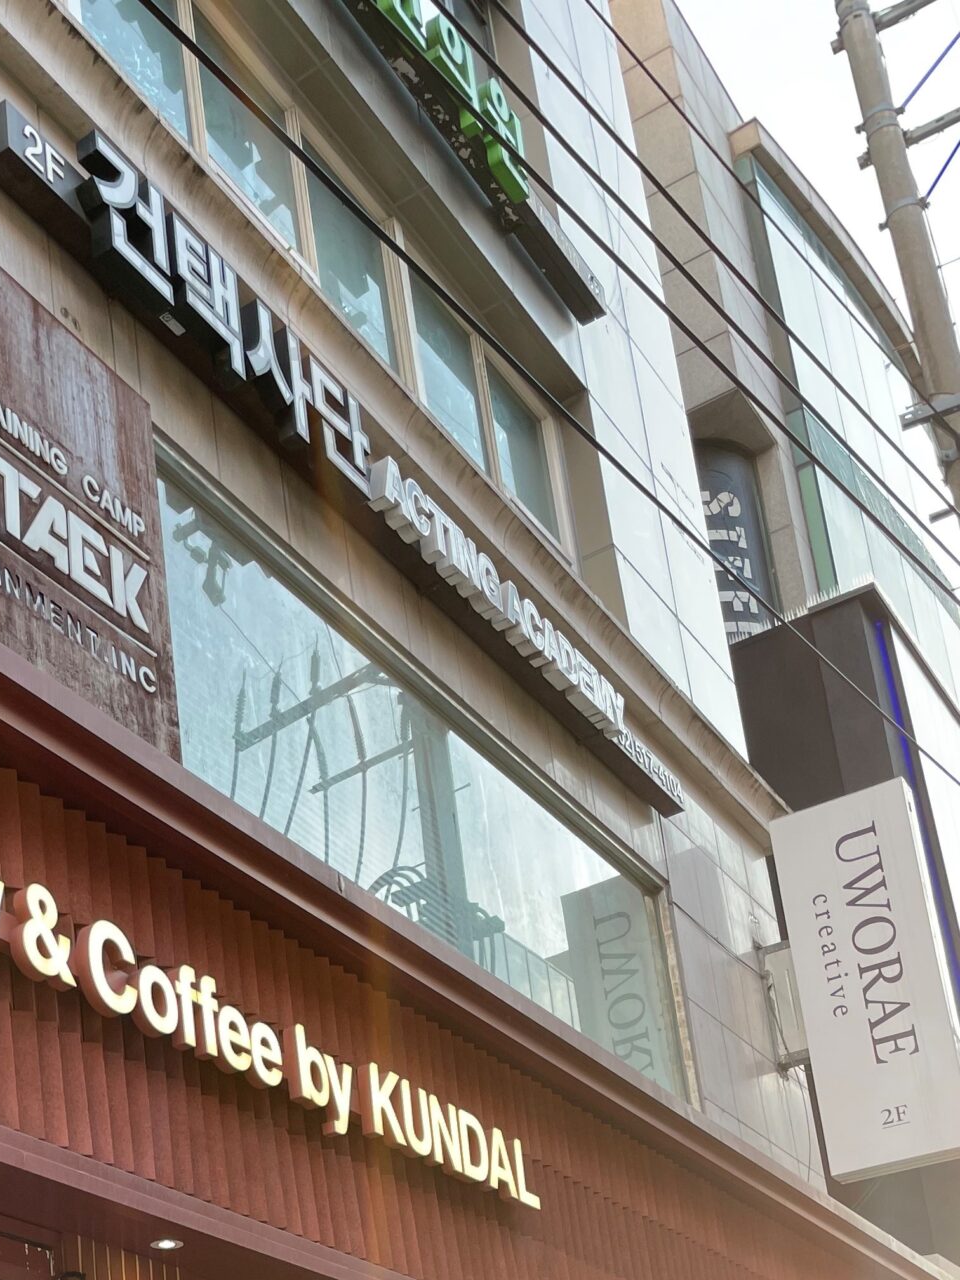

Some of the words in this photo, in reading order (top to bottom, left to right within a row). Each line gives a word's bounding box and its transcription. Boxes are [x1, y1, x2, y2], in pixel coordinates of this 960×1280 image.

[22, 124, 65, 184] 2F
[94, 133, 372, 499] 건택사단
[82, 474, 146, 536] CAMP
[384, 455, 505, 613] ACTING
[506, 579, 625, 733] ACADEMY
[812, 892, 849, 1018] creative
[834, 819, 921, 1065] UWORAE
[22, 882, 78, 988] &
[87, 919, 284, 1087] Coffee
[294, 1023, 353, 1135] by
[369, 1061, 541, 1210] KUNDAL
[880, 1103, 910, 1128] 2F
